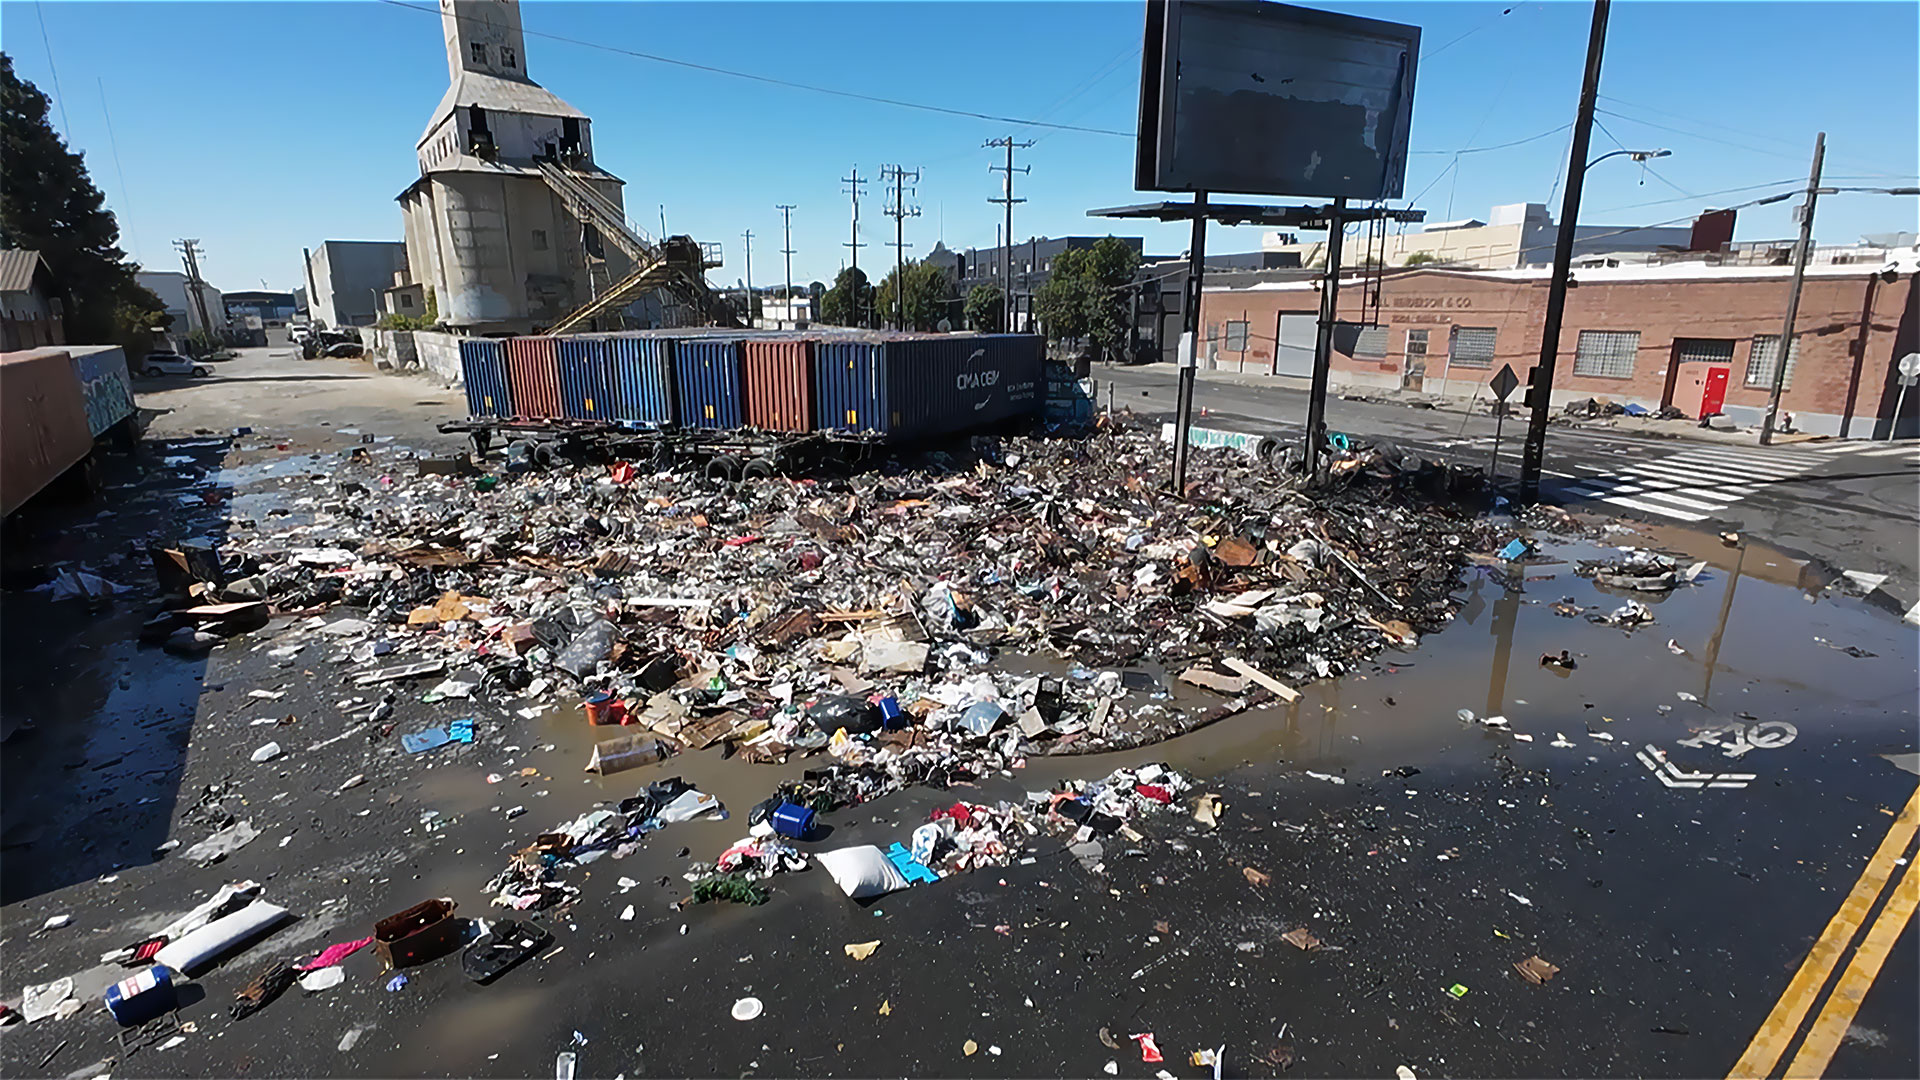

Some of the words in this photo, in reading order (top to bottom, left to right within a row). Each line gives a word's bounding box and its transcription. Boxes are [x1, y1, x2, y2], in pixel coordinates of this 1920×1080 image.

[1393, 297, 1444, 308] HENDERSON
[956, 372, 980, 391] CMA
[980, 369, 1000, 387] CGM
